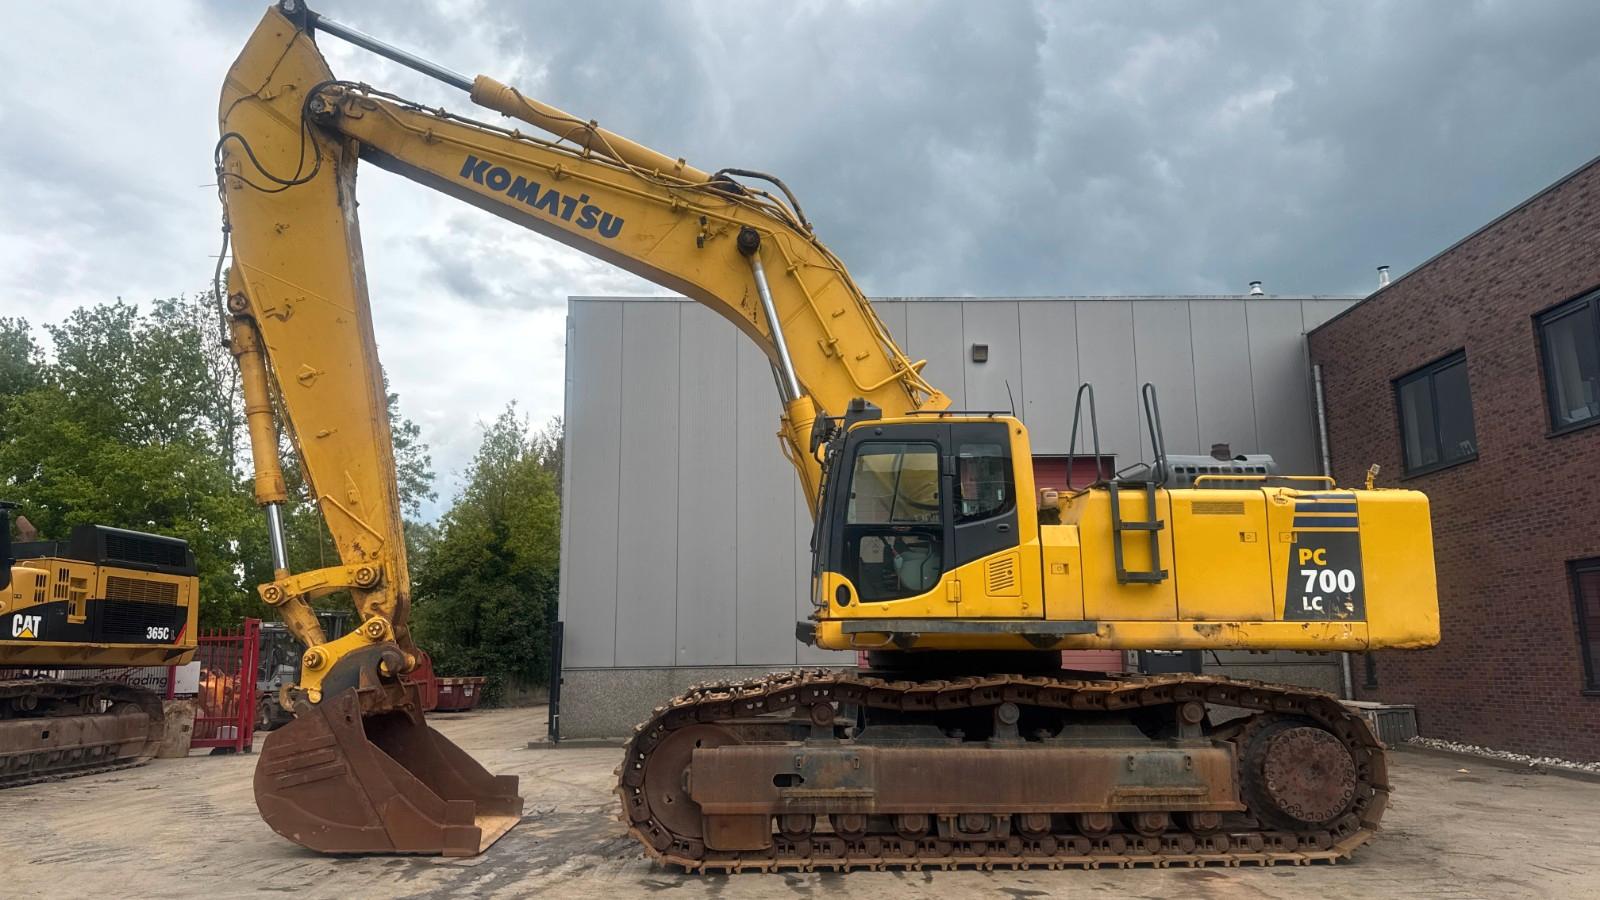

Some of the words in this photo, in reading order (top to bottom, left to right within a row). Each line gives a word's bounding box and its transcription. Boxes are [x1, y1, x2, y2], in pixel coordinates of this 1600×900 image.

[460, 154, 624, 238] KOMATSU
[1298, 548, 1327, 566] PC
[1300, 569, 1356, 593] 700
[1302, 596, 1323, 610] LC
[12, 614, 42, 638] CAT
[146, 626, 170, 640] 365C
